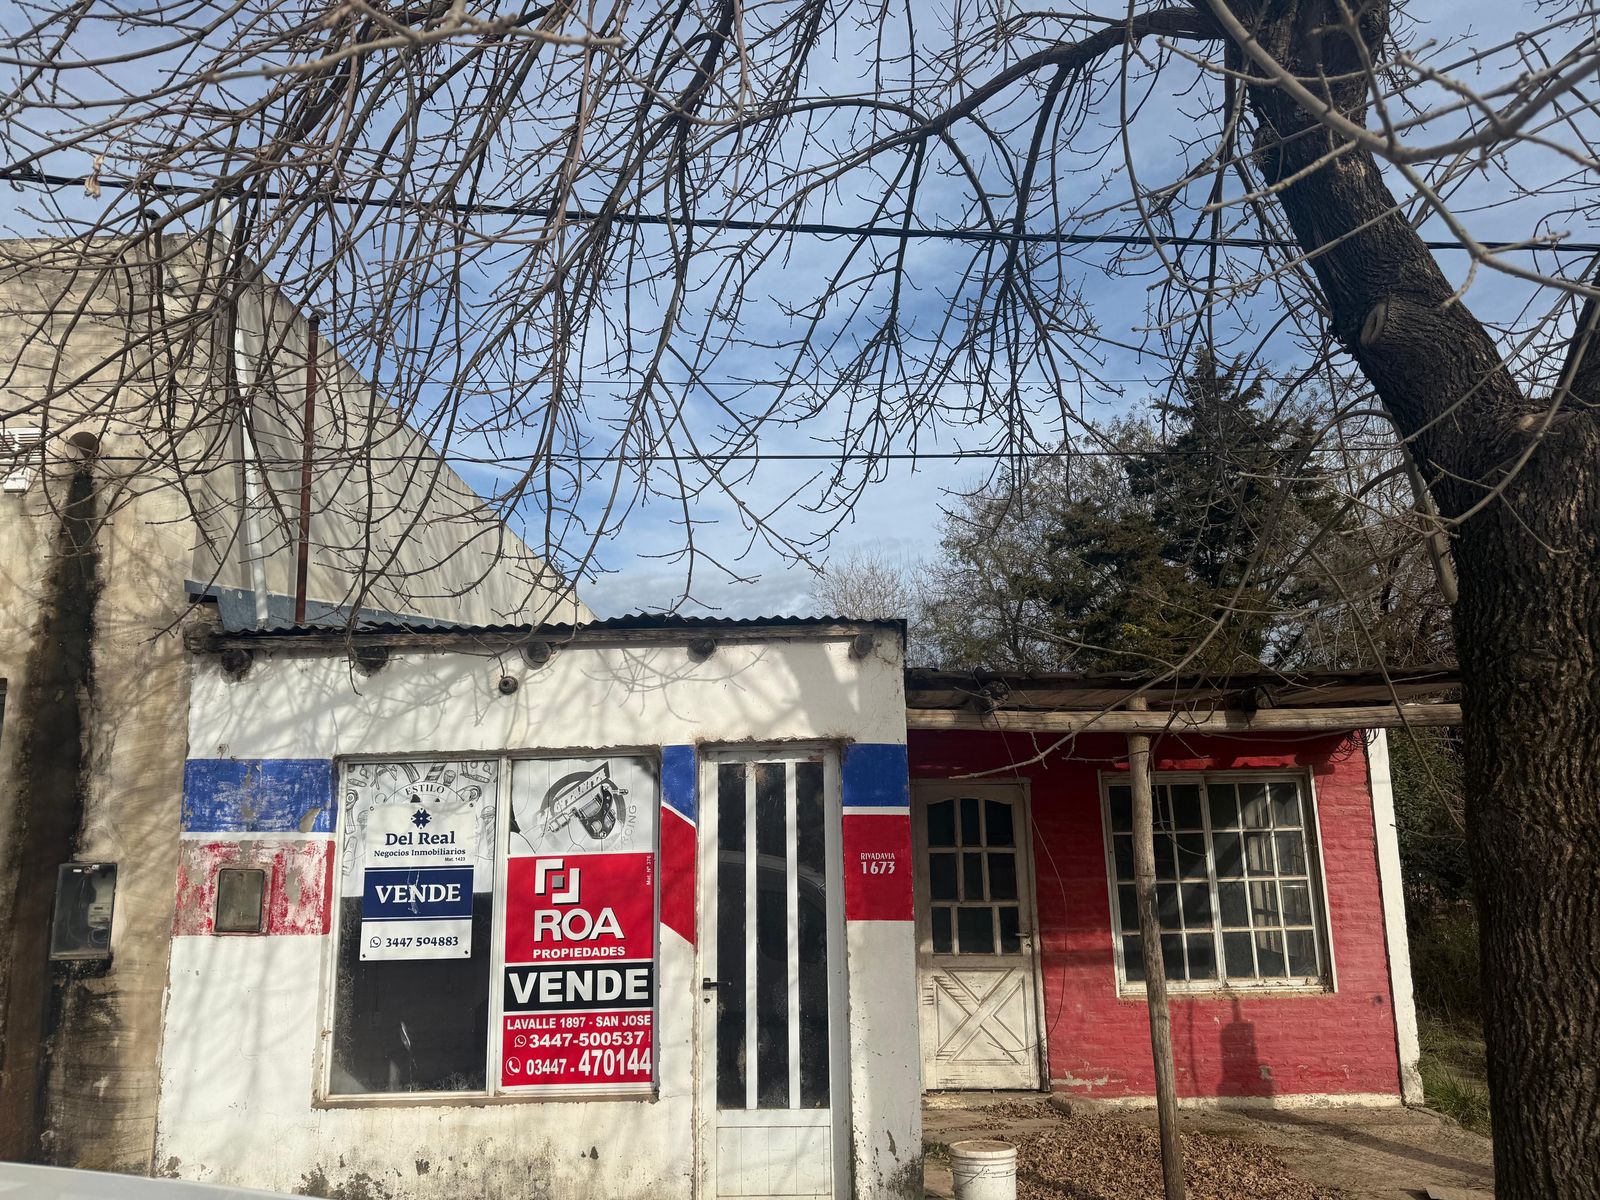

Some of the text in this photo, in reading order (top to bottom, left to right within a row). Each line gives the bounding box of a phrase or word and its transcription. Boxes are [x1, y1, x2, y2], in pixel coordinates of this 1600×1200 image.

[405, 784, 445, 796] ESTILO
[385, 831, 456, 846] Del Real
[374, 847, 466, 859] Negocios Inmobiliarios
[860, 852, 896, 860] RIVADAVIA
[860, 861, 896, 875] 1673
[375, 884, 461, 904] VENDE
[533, 907, 625, 942] ROA
[385, 936, 459, 948] 3447 504883
[533, 946, 626, 959] PROPIEDADES
[508, 968, 649, 1004] VENDE
[506, 1017, 557, 1030] LAVALLE
[560, 1016, 586, 1028] 1897
[595, 1015, 619, 1027] SAN
[622, 1014, 651, 1027] JOSE
[528, 1031, 645, 1048] 3447-500537
[526, 1058, 567, 1075] 03447
[578, 1048, 651, 1076] 470144
